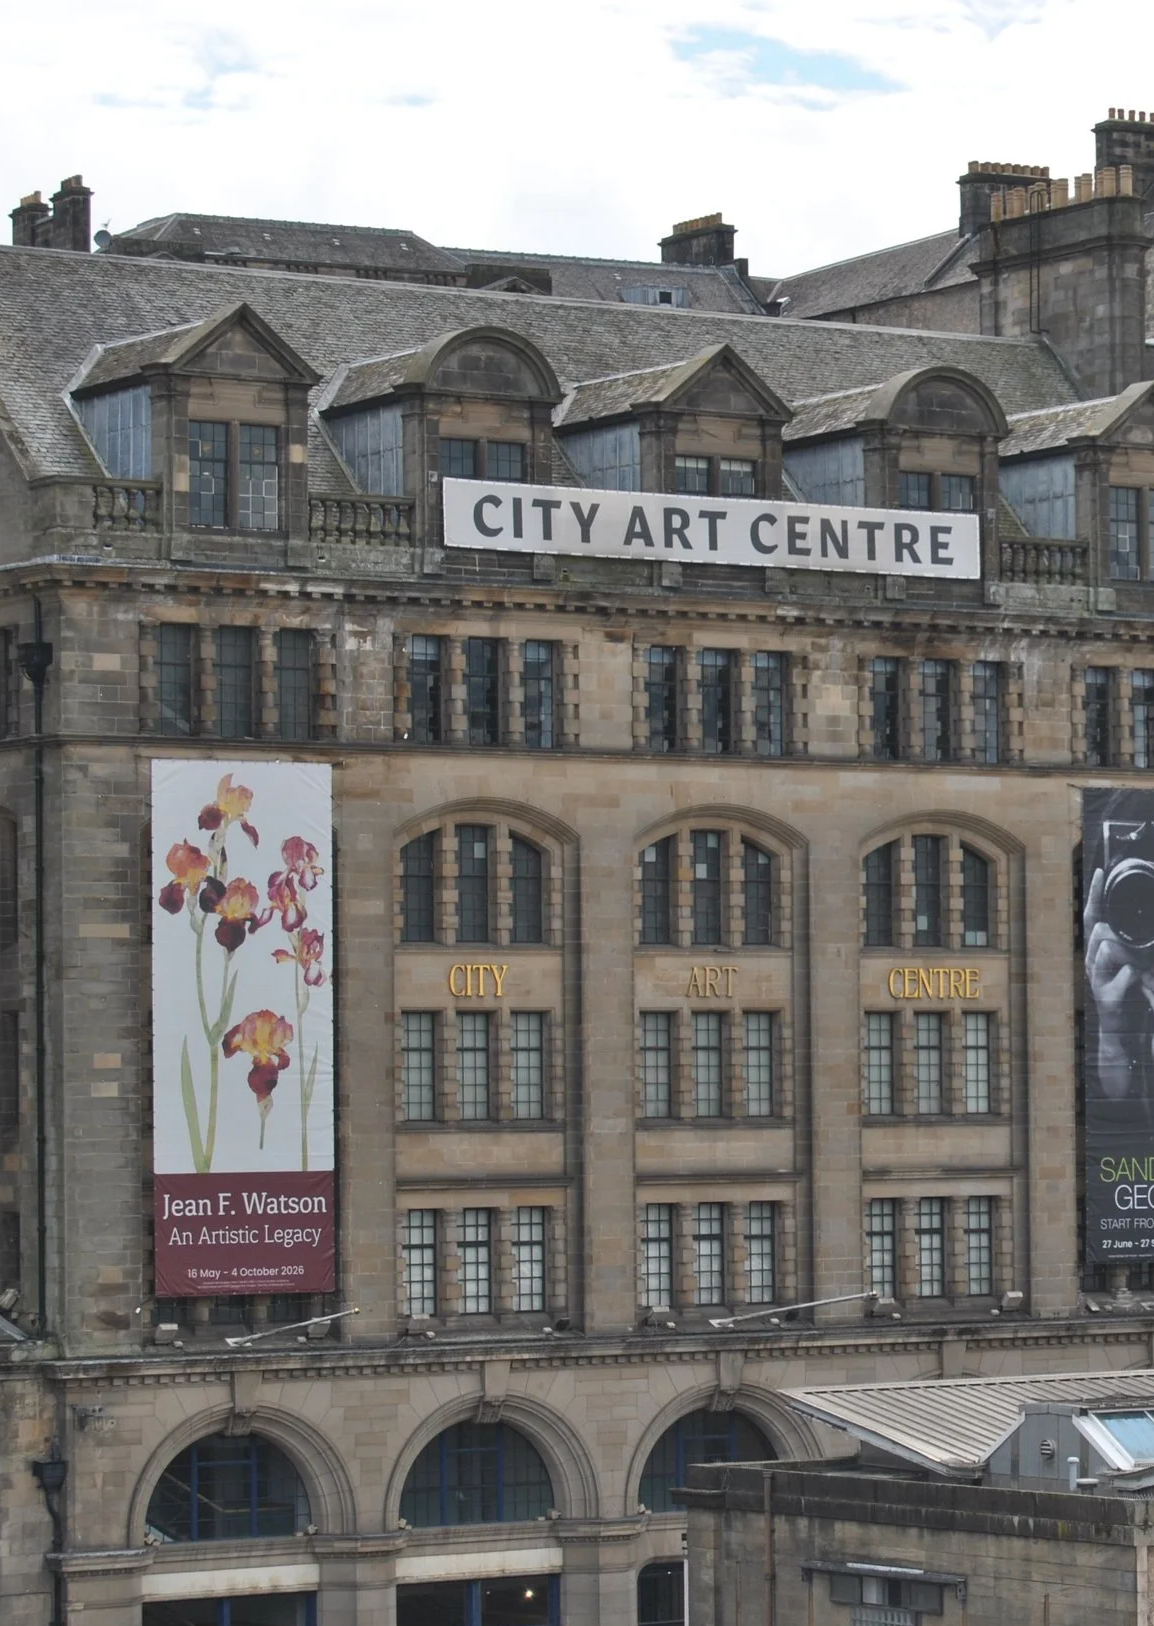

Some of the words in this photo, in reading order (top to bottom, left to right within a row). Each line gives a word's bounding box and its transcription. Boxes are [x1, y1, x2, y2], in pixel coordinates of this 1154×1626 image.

[473, 494, 599, 544] CITY
[623, 505, 727, 551] ART
[750, 512, 954, 566] CENTRE
[448, 964, 508, 998] CITY
[686, 966, 739, 999] ART
[888, 967, 980, 1000] CENTRE
[162, 1194, 212, 1220] Jean
[217, 1192, 236, 1216] F.
[241, 1191, 327, 1215] Watson
[168, 1226, 193, 1246] An
[198, 1225, 259, 1246] Artistic
[264, 1224, 322, 1248] Legacy
[1100, 1218, 1131, 1230] START
[1102, 1239, 1112, 1249] 27
[1113, 1239, 1133, 1249] June
[1140, 1238, 1150, 1248] 27
[187, 1268, 198, 1279] 16
[200, 1268, 221, 1280] May
[231, 1267, 238, 1277] 4
[240, 1266, 279, 1277] October
[281, 1265, 305, 1276] 2026
